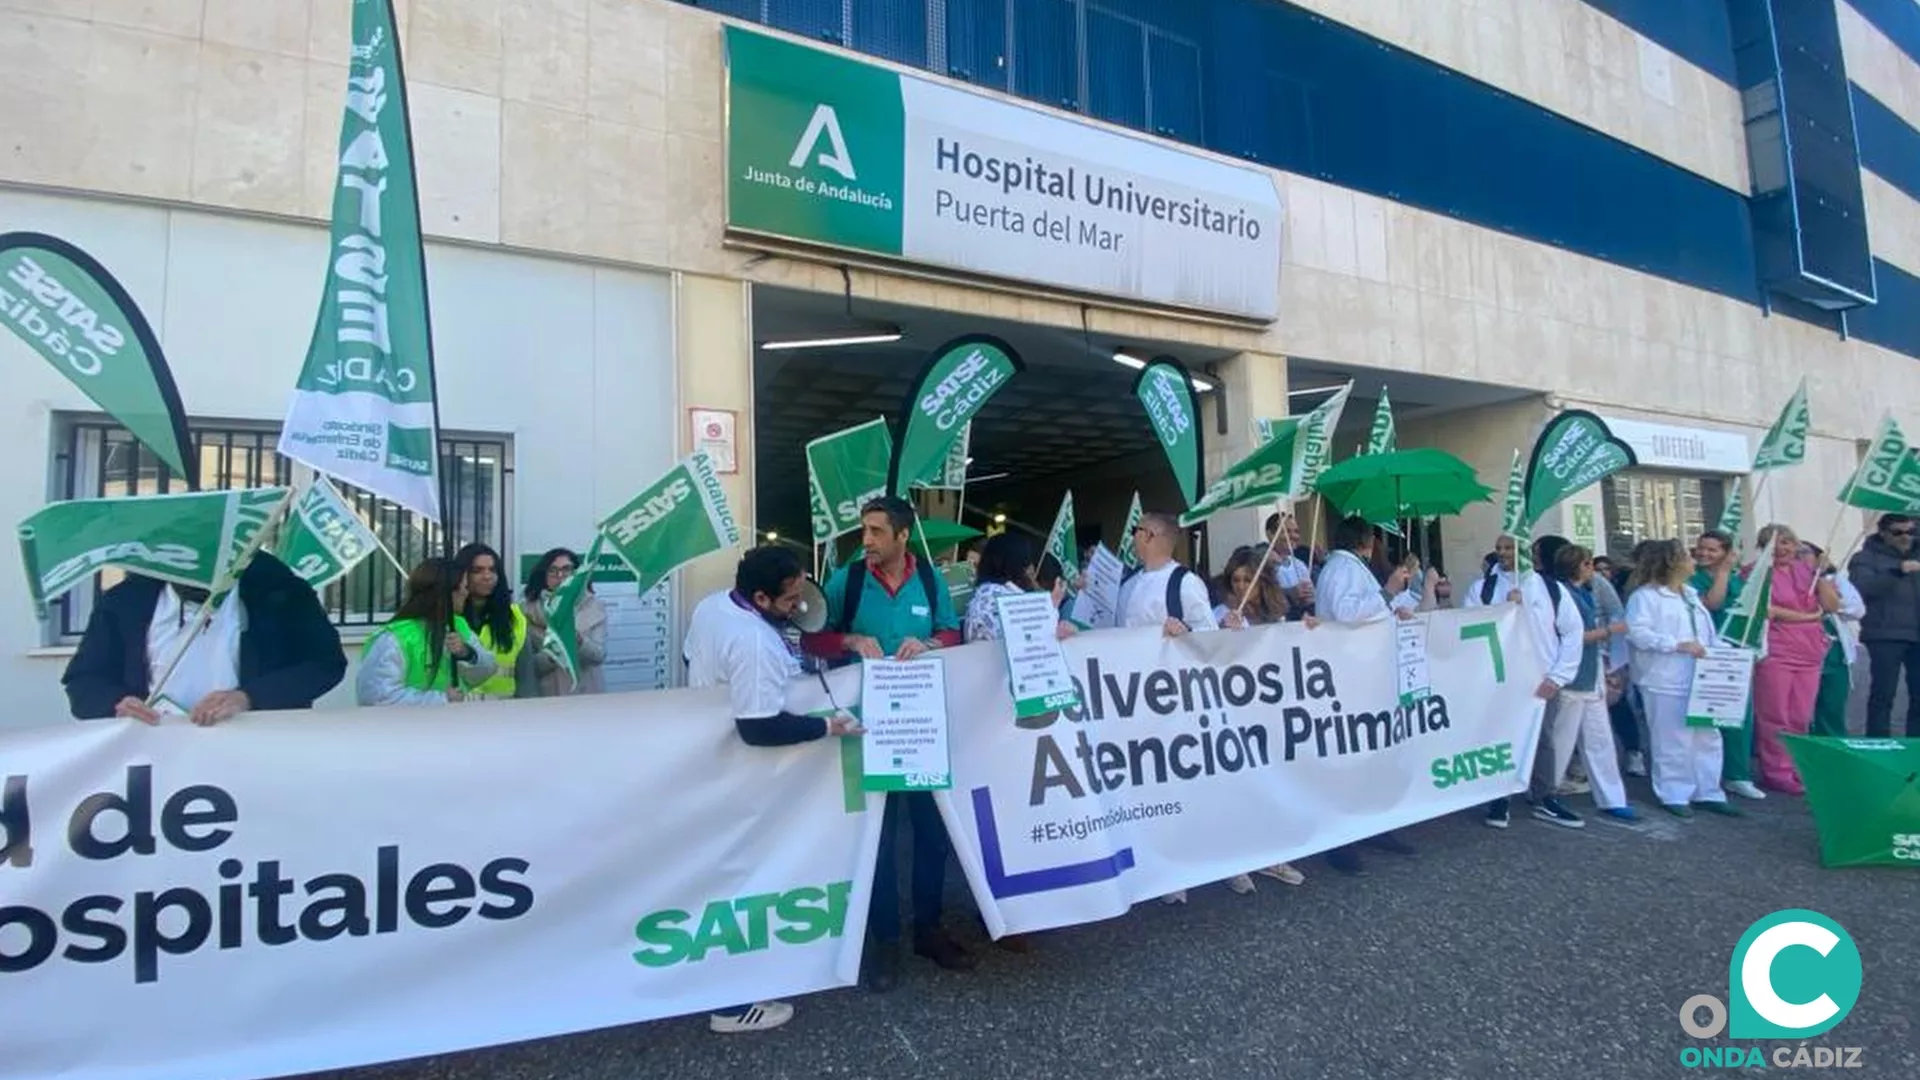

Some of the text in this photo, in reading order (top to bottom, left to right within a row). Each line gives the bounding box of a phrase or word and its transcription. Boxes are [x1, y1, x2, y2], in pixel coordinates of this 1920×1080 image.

[744, 166, 893, 210] Junta de Andalucía
[936, 138, 1261, 241] Hospital Universitario
[936, 190, 1124, 252] Puerta del Mar
[921, 351, 988, 416] SATSE
[936, 368, 1005, 431] Cádiz
[1543, 421, 1586, 469] SATSE
[609, 477, 692, 545] SATSE
[692, 452, 741, 545] Andalucía
[1015, 646, 1336, 729] alvemos la
[1029, 694, 1451, 807] Atención Primaria
[1431, 742, 1516, 789] SATSE
[68, 764, 239, 861] de
